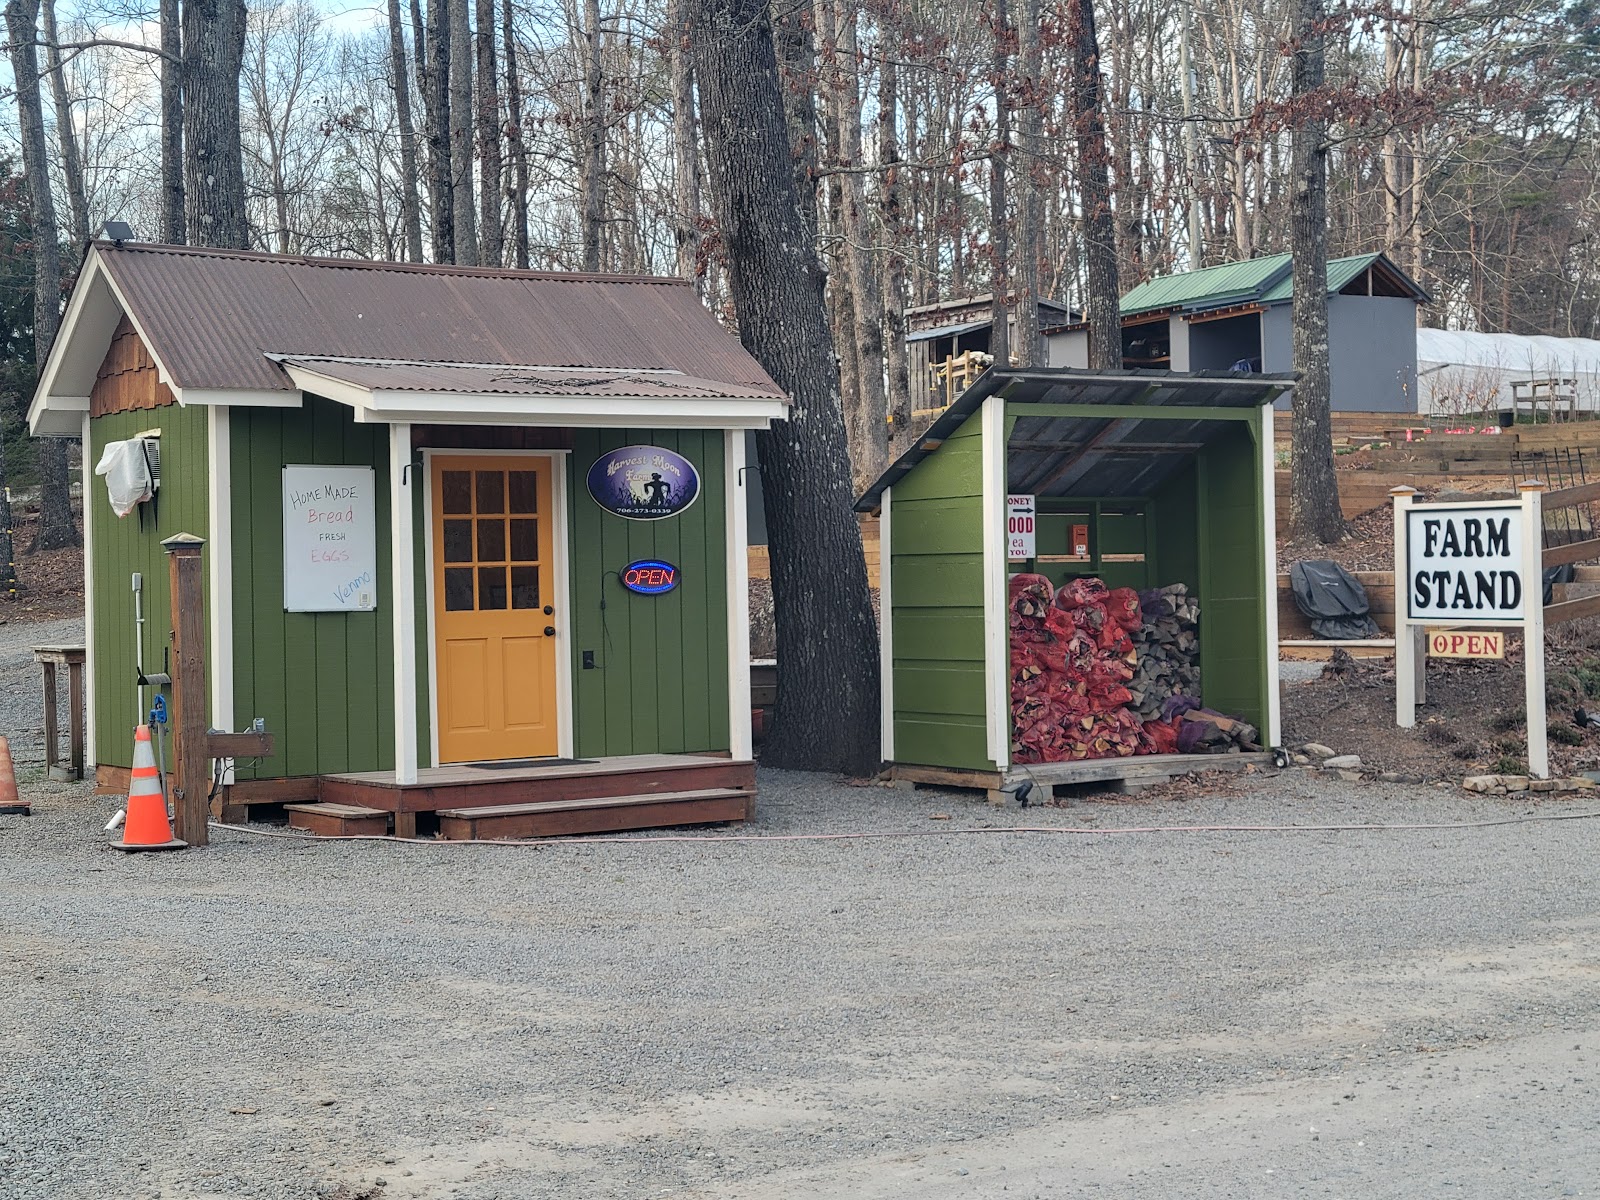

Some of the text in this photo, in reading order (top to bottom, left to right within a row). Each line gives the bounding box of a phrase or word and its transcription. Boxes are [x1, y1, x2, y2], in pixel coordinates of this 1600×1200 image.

[607, 454, 681, 477] Harvest Moon
[289, 484, 359, 510] HOME MADE
[1007, 497, 1031, 505] ONEY
[307, 505, 354, 524] Bread
[1009, 516, 1033, 534] OOD
[319, 532, 346, 541] FRESH
[1423, 517, 1511, 558] FARM
[624, 569, 675, 585] OPEN
[334, 571, 371, 604] Venmo
[1414, 570, 1522, 610] STAND
[1433, 635, 1499, 655] OPEN
